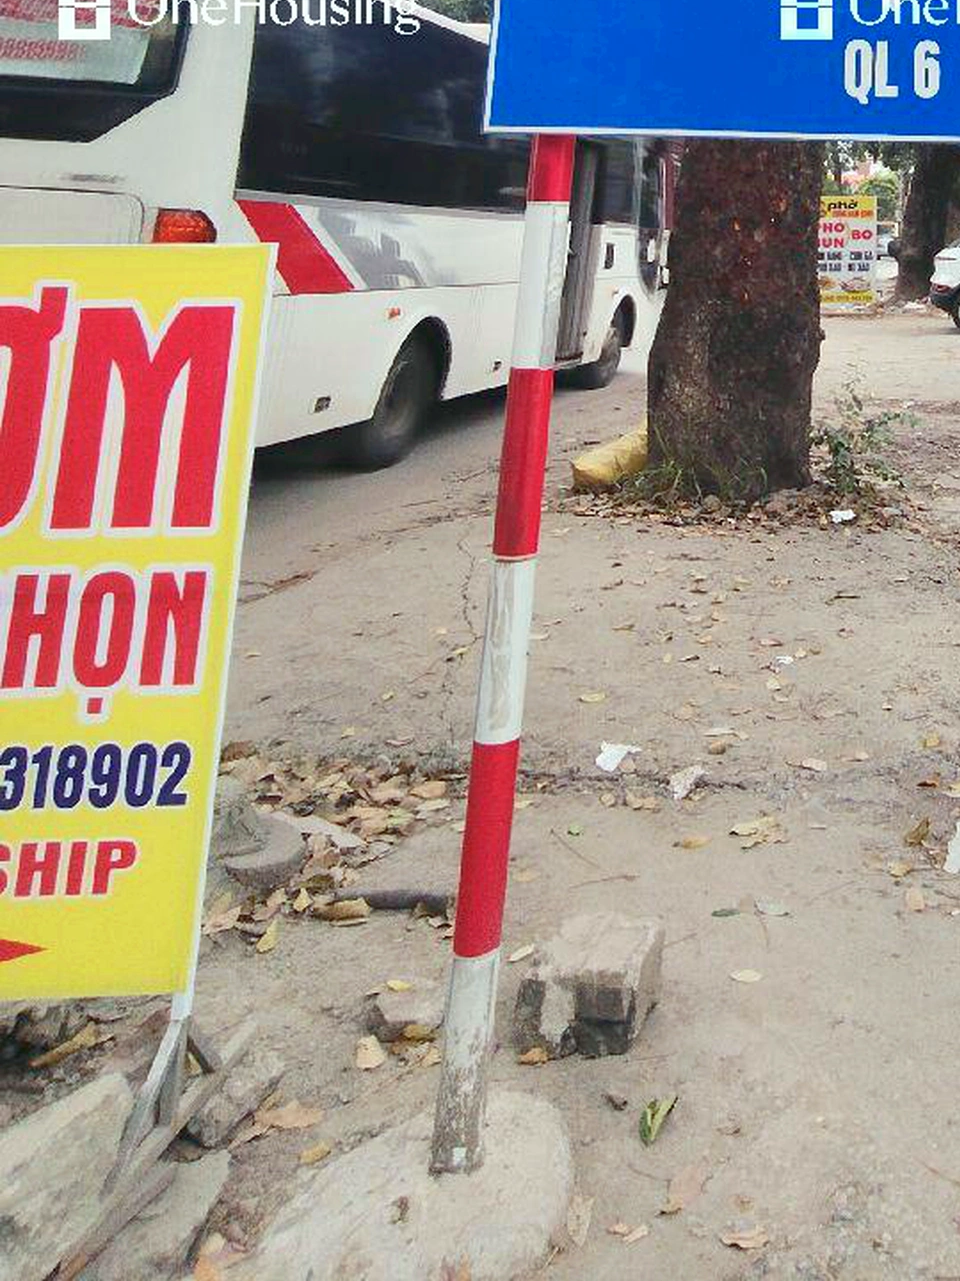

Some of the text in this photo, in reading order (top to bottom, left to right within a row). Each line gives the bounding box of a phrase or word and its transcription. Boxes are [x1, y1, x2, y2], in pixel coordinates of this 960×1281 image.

[843, 39, 941, 105] QL 6
[1, 570, 208, 715] HỌN
[0, 741, 192, 810] 318902
[0, 840, 138, 898] HIP
